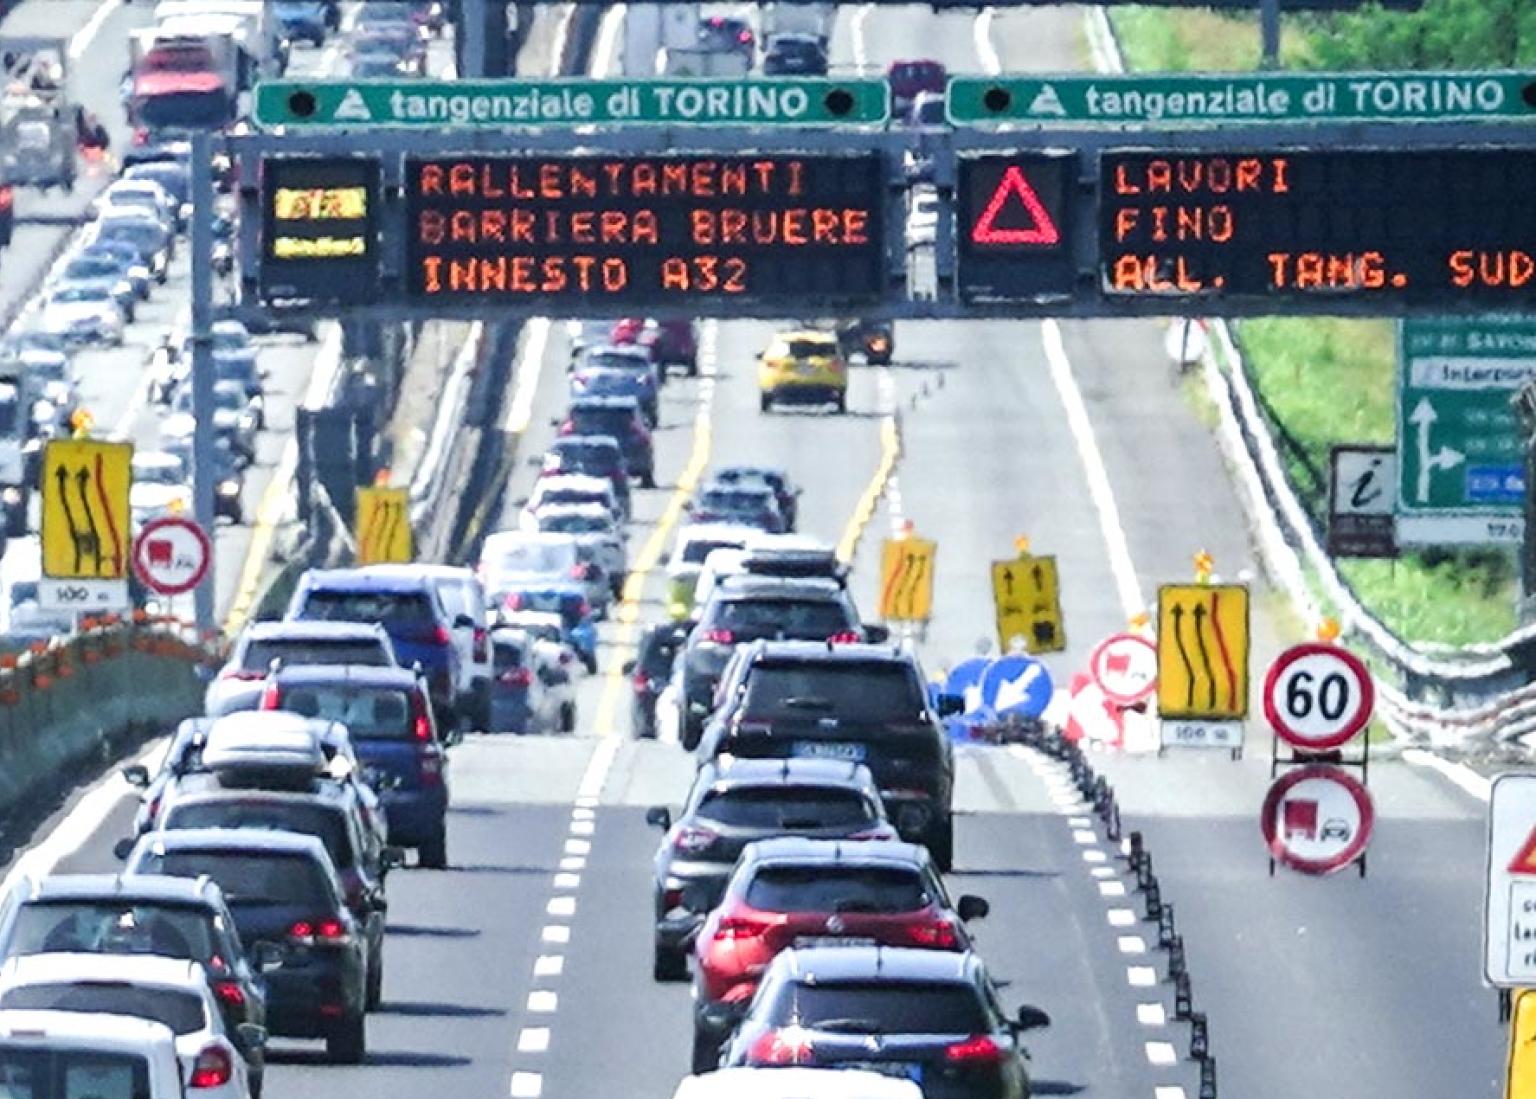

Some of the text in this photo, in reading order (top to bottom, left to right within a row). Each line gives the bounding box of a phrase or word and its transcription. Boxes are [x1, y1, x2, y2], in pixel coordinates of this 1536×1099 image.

[390, 85, 809, 123] tangenziale di TORINO
[1085, 80, 1505, 119] tangenziale di TORINO
[420, 160, 803, 199] RALLENTAMENTI
[1114, 158, 1290, 195] LAVORI
[420, 208, 869, 246] BARRIERA BRUERE
[1114, 205, 1234, 242] FINO
[423, 255, 747, 293] INNESTO A32
[1113, 248, 1536, 292] ALL. TANG. SUD
[1286, 670, 1350, 721] 60
